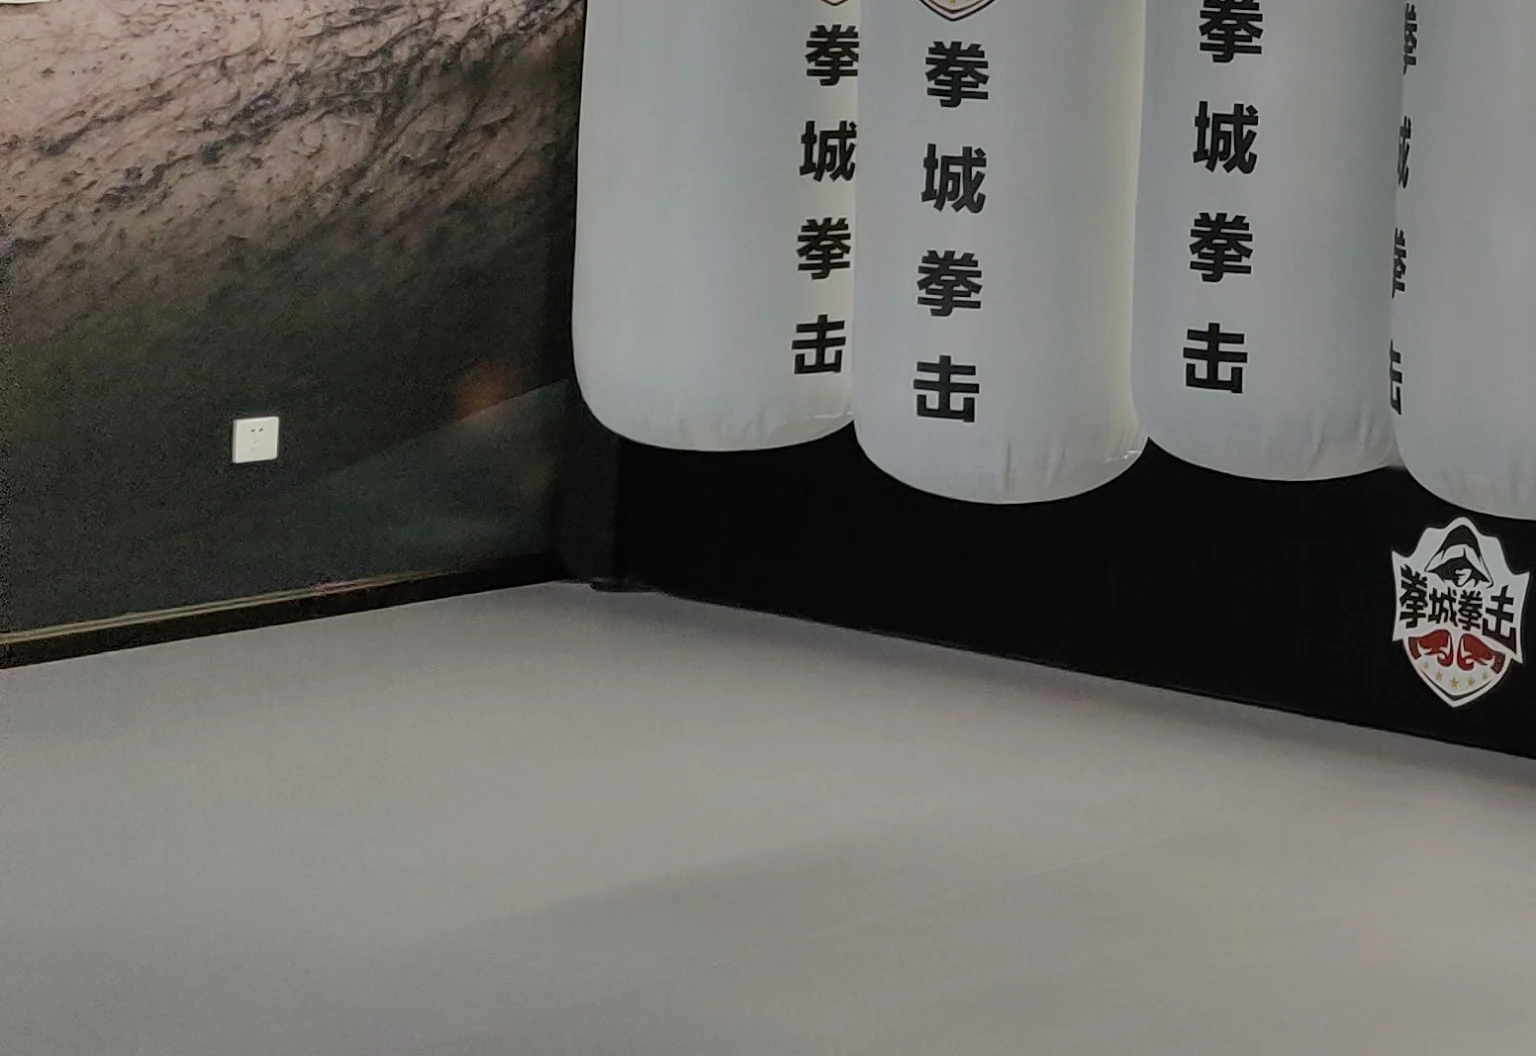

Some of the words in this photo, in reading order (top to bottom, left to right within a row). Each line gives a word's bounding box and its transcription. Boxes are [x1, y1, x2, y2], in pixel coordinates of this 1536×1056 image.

[791, 24, 860, 375] 拳城拳击
[912, 40, 990, 423] 拳城拳击
[1398, 565, 1520, 644] 拳城拳击
